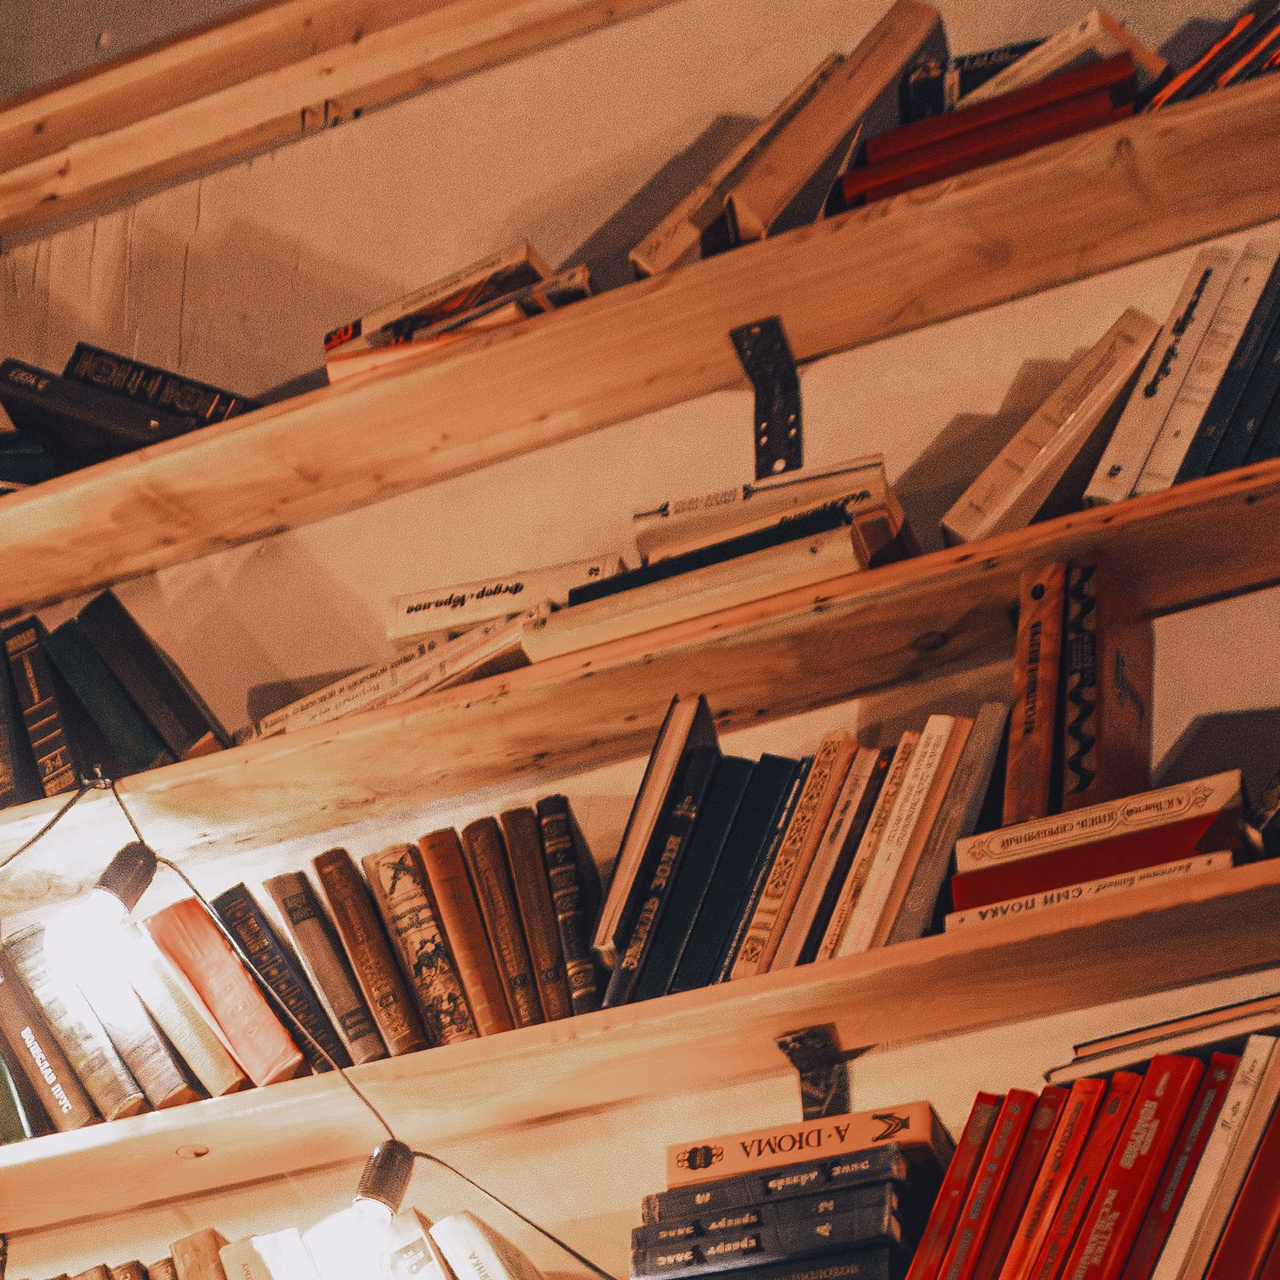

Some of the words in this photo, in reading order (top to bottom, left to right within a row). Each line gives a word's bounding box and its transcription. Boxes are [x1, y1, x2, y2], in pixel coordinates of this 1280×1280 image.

[619, 894, 660, 972] ЭМИЛЬ
[649, 833, 682, 893] ЗОЛЯ
[976, 897, 1037, 922] ПОЛКА
[1041, 885, 1084, 905] СЫН
[19, 1025, 57, 1086] БОЛЕСЛАВ
[50, 1082, 73, 1115] ПРУС
